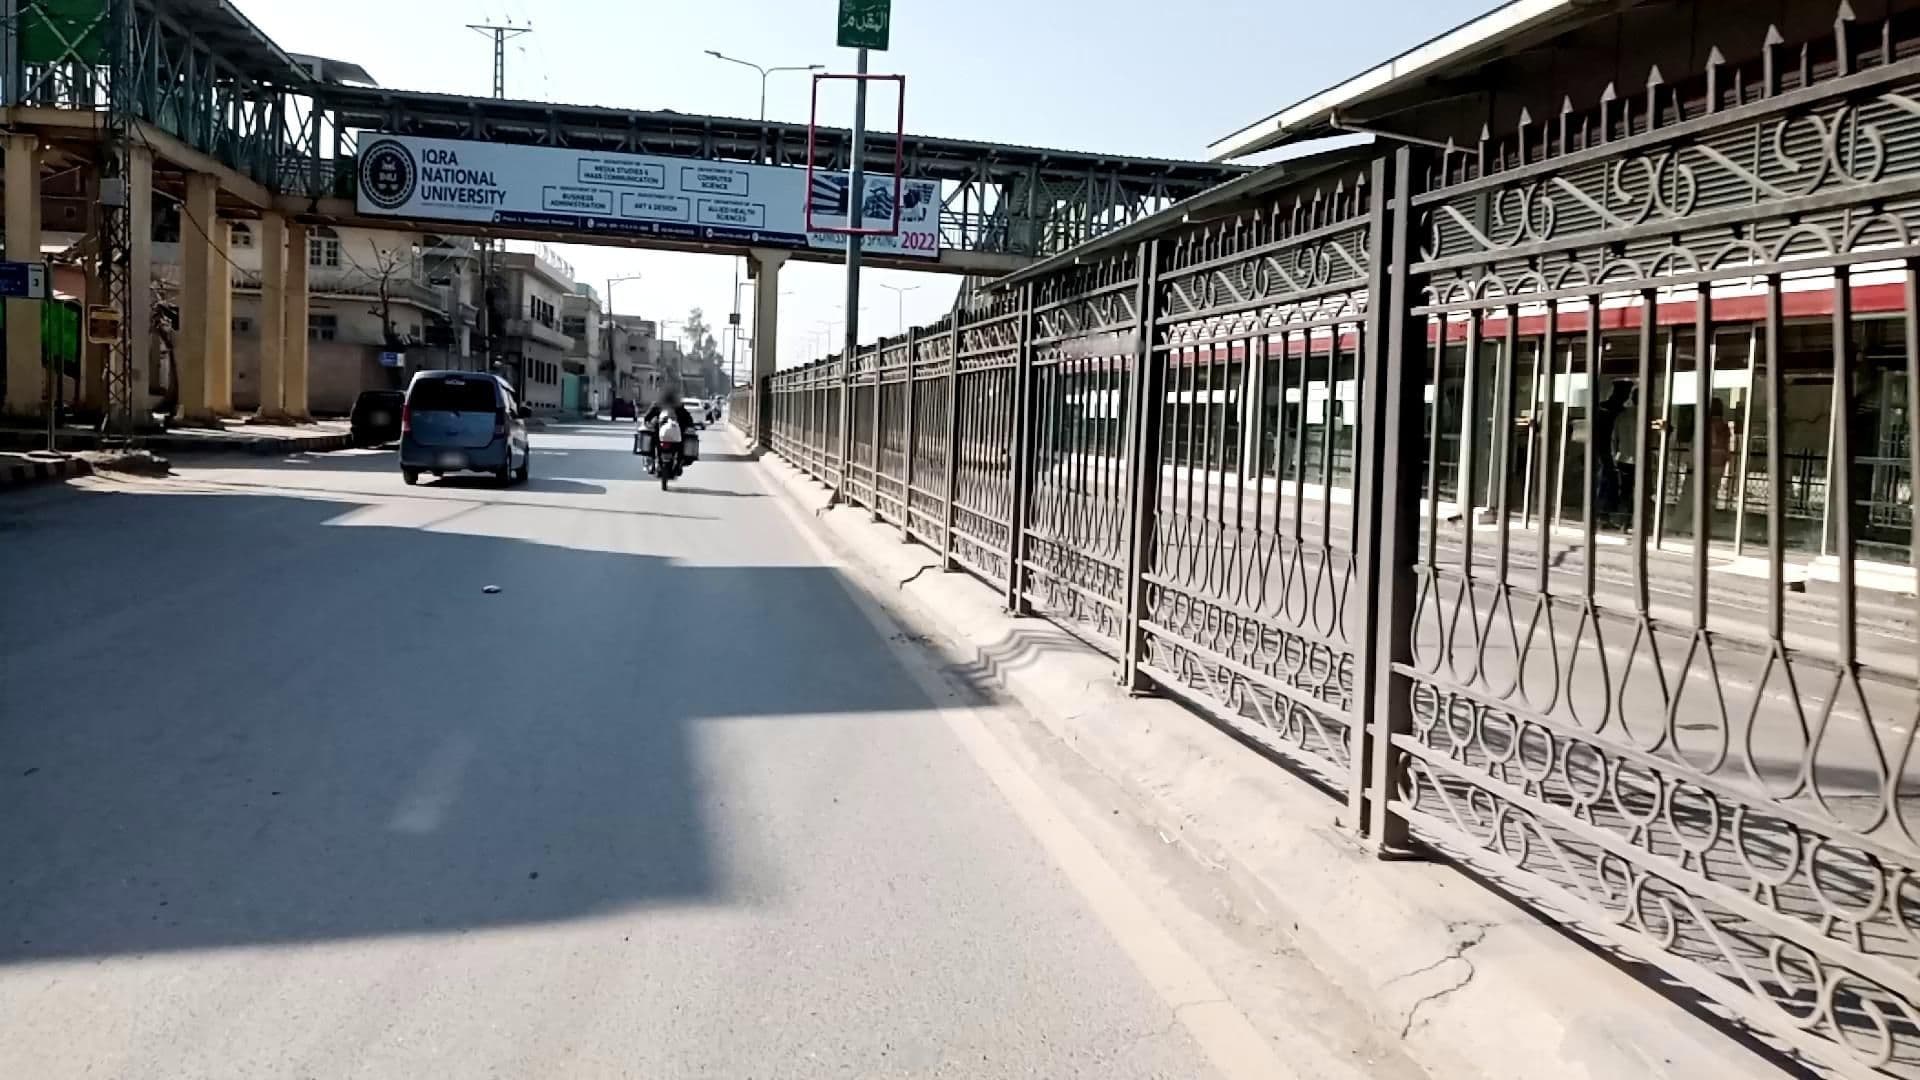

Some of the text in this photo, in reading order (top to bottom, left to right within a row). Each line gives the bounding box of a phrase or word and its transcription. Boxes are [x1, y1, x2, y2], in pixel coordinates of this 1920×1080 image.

[421, 148, 459, 166] IQRA
[594, 165, 615, 174] MEDIA
[616, 167, 644, 176] STUDIES
[420, 167, 497, 187] NATIONAL
[603, 173, 659, 184] COMMUNICATION
[697, 174, 733, 183] COMPUTER
[701, 182, 728, 190] SCIENCE
[420, 185, 507, 206] UNIVERSITY
[562, 193, 594, 202] BUSINESS
[550, 199, 606, 209] ADMINISTRATION
[653, 204, 678, 212] DESIGN
[730, 207, 756, 215] HEALTH
[716, 213, 747, 222] SCIENCES
[901, 231, 936, 251] 2022
